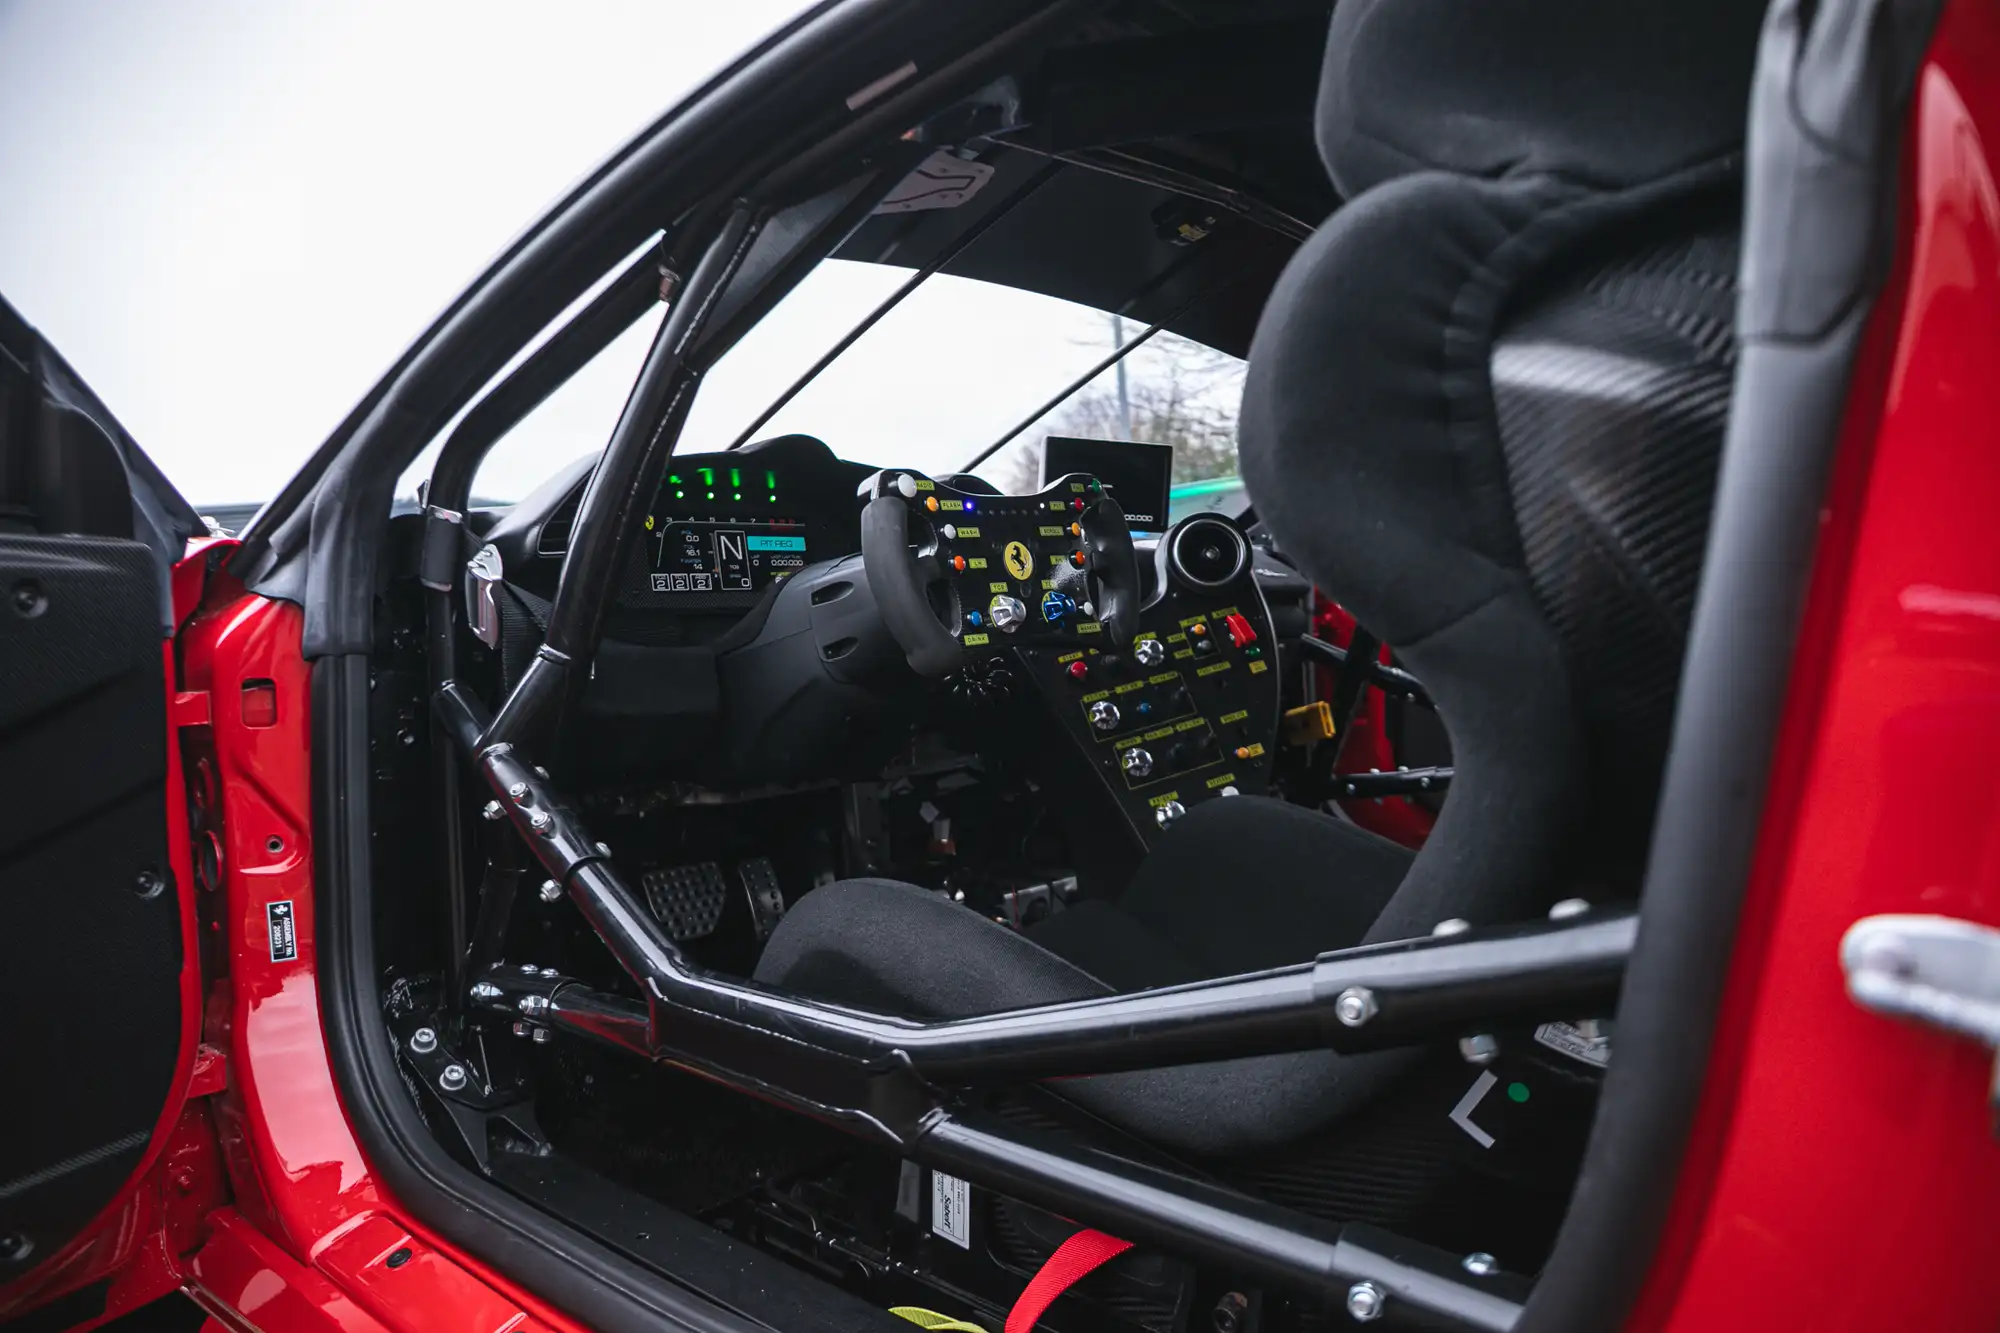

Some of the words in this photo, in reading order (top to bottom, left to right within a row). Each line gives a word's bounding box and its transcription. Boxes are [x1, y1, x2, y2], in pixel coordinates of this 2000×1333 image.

[720, 535, 743, 560] N
[656, 580, 666, 589] 2
[676, 580, 685, 589] 2
[697, 580, 706, 589] 2
[283, 917, 292, 946] ASSEMBLY
